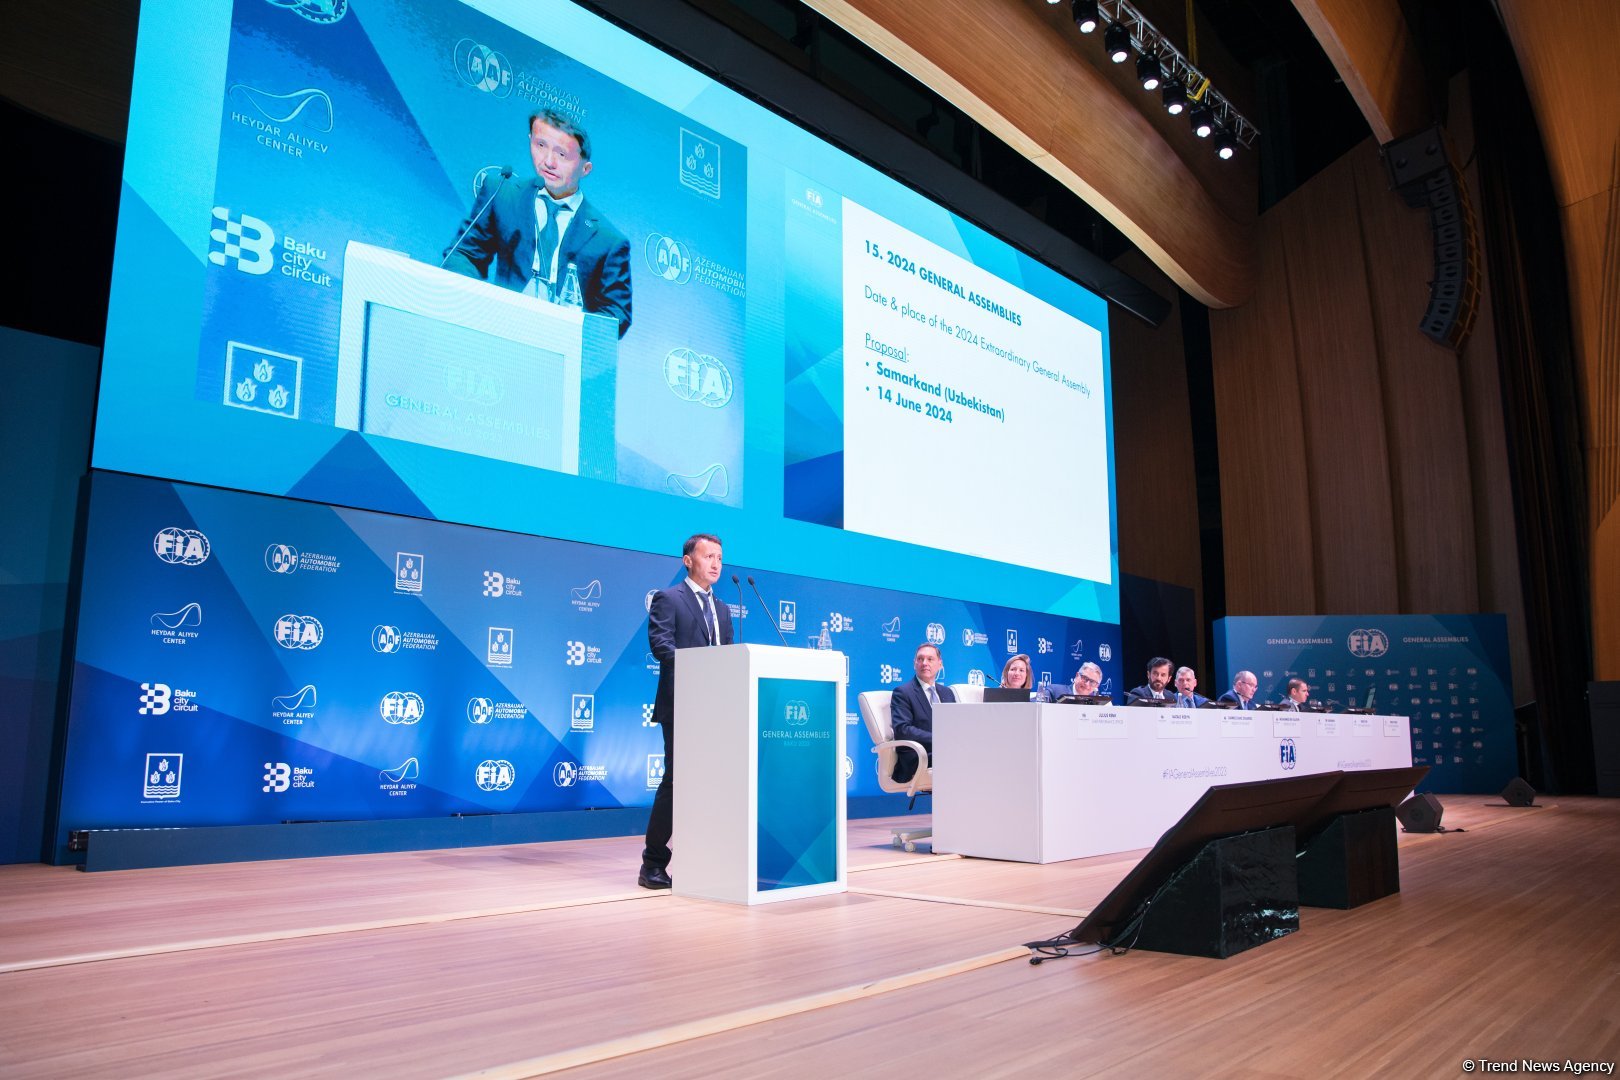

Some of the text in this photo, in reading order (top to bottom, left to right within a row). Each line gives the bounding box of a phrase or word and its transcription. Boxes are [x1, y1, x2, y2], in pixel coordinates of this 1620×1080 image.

[518, 71, 580, 105] AZERBAIJAN
[518, 81, 588, 117] AUTOMOBILE
[231, 111, 328, 153] HEYDAR ALIYEV
[256, 134, 303, 158] CENTER
[283, 236, 327, 260] Baku
[694, 265, 746, 290] AUTOMOBIL
[695, 256, 745, 281] AZERBAIJAN
[695, 273, 746, 298] FEDERATION
[864, 239, 1022, 326] 15. 2024 GENERAL ASSEMBLIES
[864, 284, 1091, 399] Date & place of the 2024 Extraordinary General Assembly
[864, 333, 910, 362] Proposal:
[876, 361, 1006, 423] Samarkand (Uzbekistan)
[877, 385, 953, 424] 14 June 2024
[300, 552, 336, 562] AZERBAIJAN
[300, 558, 340, 568] AUTOMOBILE
[300, 563, 337, 573] FEDERATION
[505, 577, 521, 585] Baku
[151, 629, 176, 637] HEYDAR
[163, 637, 186, 645] CENTER
[402, 637, 439, 645] AUTOMOBILE
[1296, 637, 1333, 645] ASSEMBLIES
[587, 645, 601, 653] Baku
[174, 689, 196, 698] Baku
[793, 731, 830, 739] ASSEMBLIES
[294, 767, 313, 775] Baku
